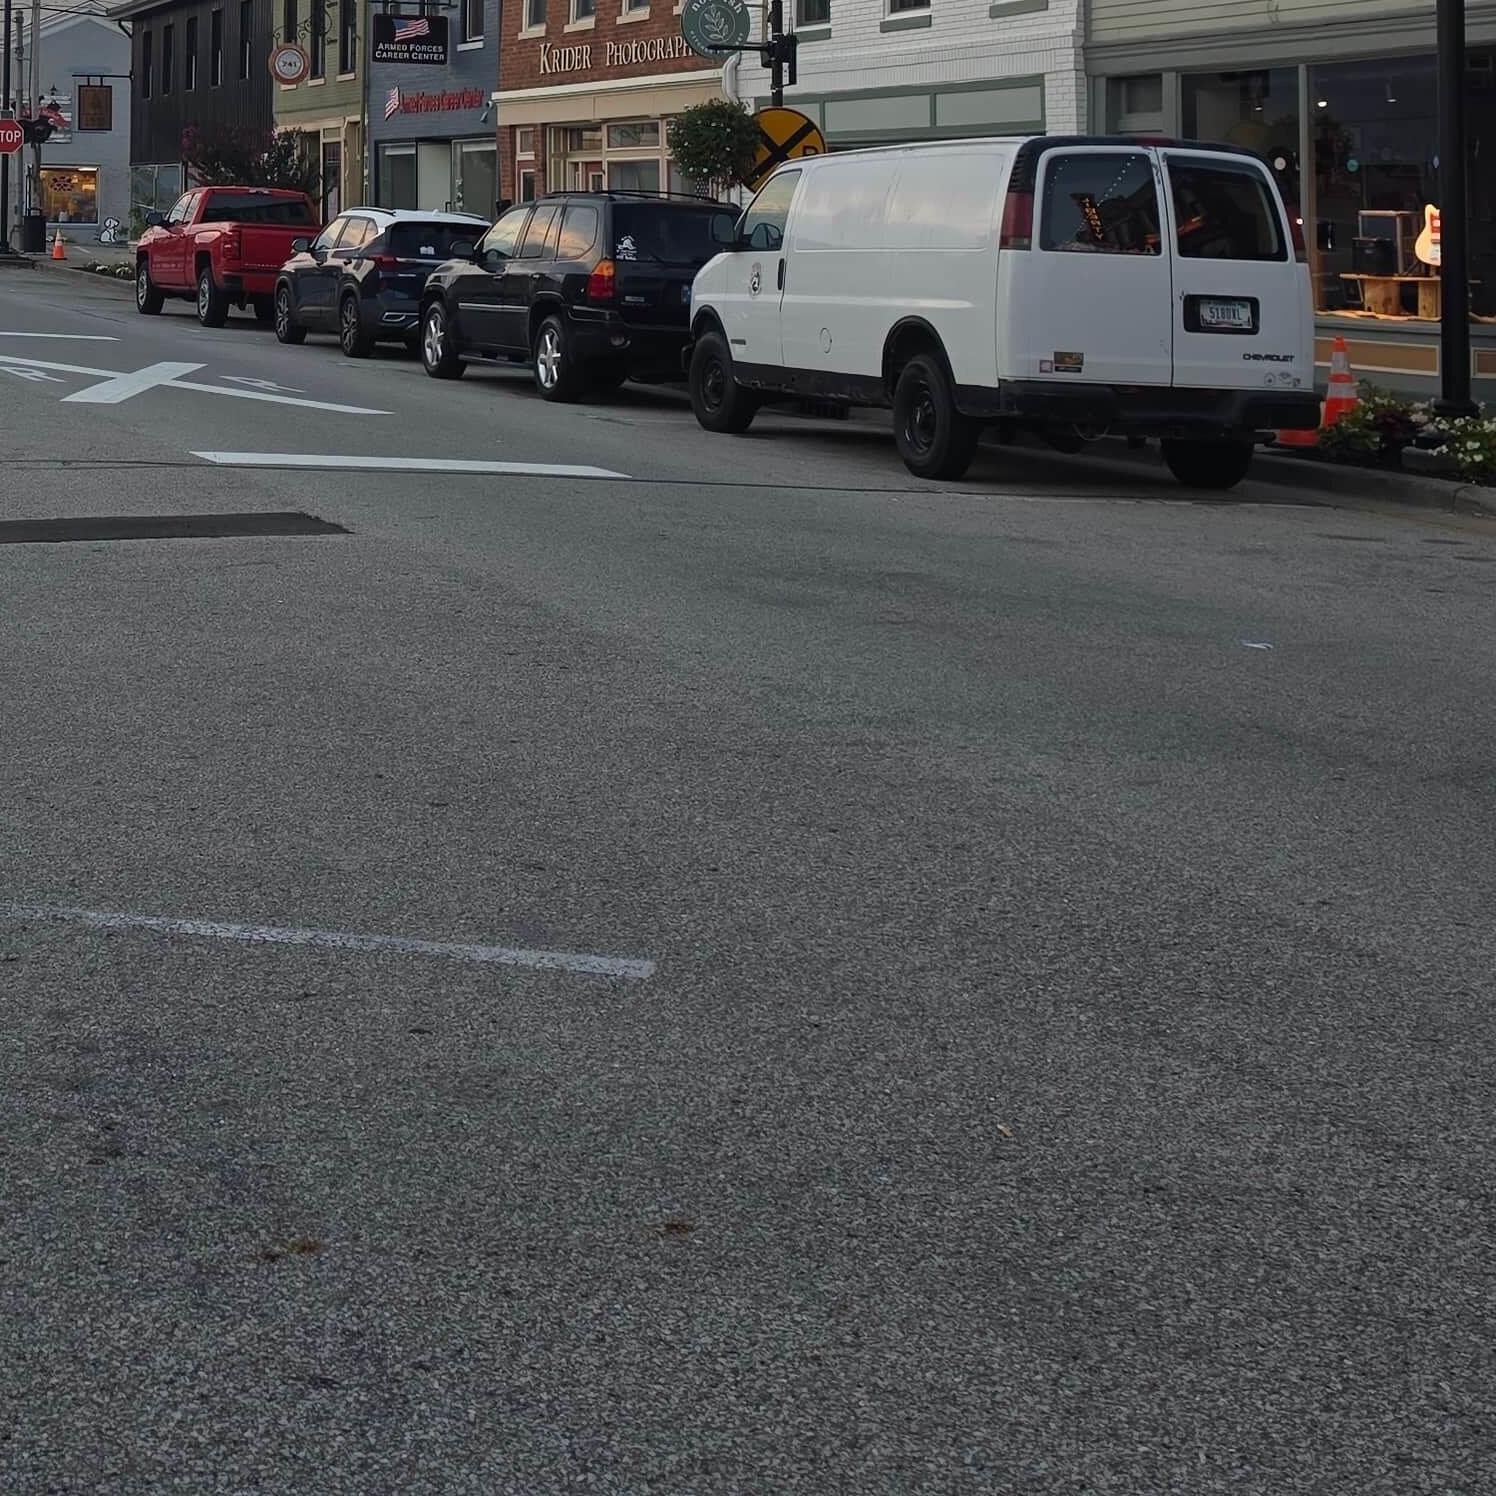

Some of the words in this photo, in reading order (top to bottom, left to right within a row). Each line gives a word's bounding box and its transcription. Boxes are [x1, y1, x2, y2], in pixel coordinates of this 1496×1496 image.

[377, 42, 407, 51] ARMED
[409, 43, 444, 53] FORCES
[375, 50, 409, 59] CAREER
[411, 52, 445, 61] CENTER
[539, 43, 592, 74] KRIDER
[1242, 353, 1295, 362] CHEVROLET
